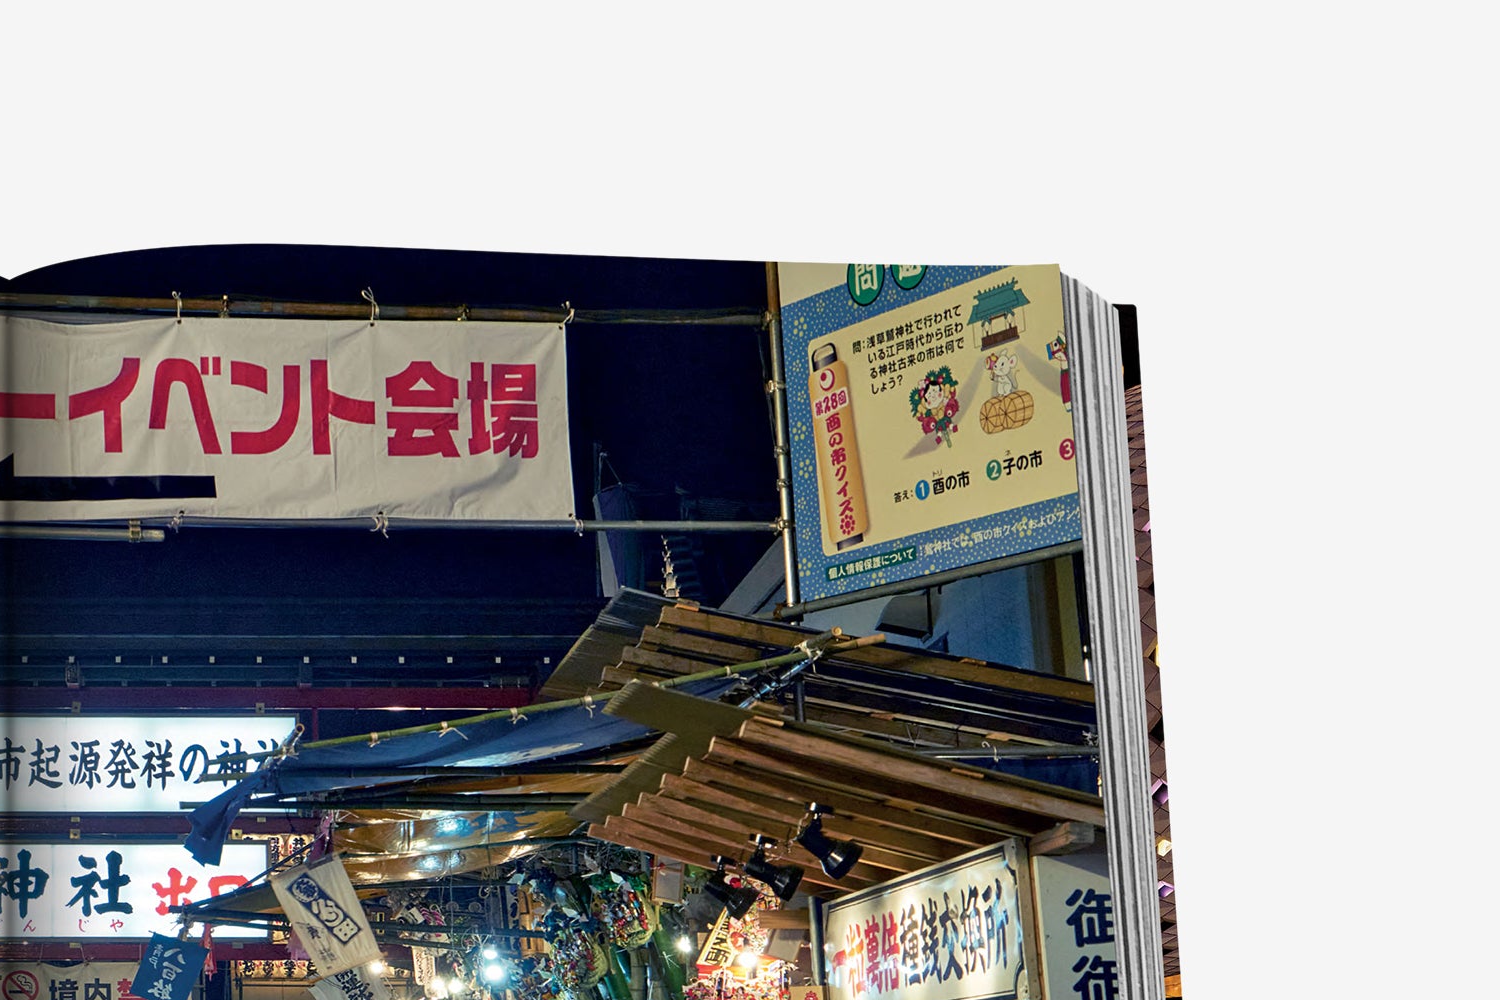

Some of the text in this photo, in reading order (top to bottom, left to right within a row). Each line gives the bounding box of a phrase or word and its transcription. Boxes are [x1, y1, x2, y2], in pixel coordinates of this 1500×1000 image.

[868, 322, 964, 364] いる江戸時代から伝わ
[870, 337, 965, 379] る神社古来の市は何で
[1003, 450, 1043, 476] 子の市
[932, 471, 970, 495] 酉の市
[828, 548, 916, 579] 個人情報保護について
